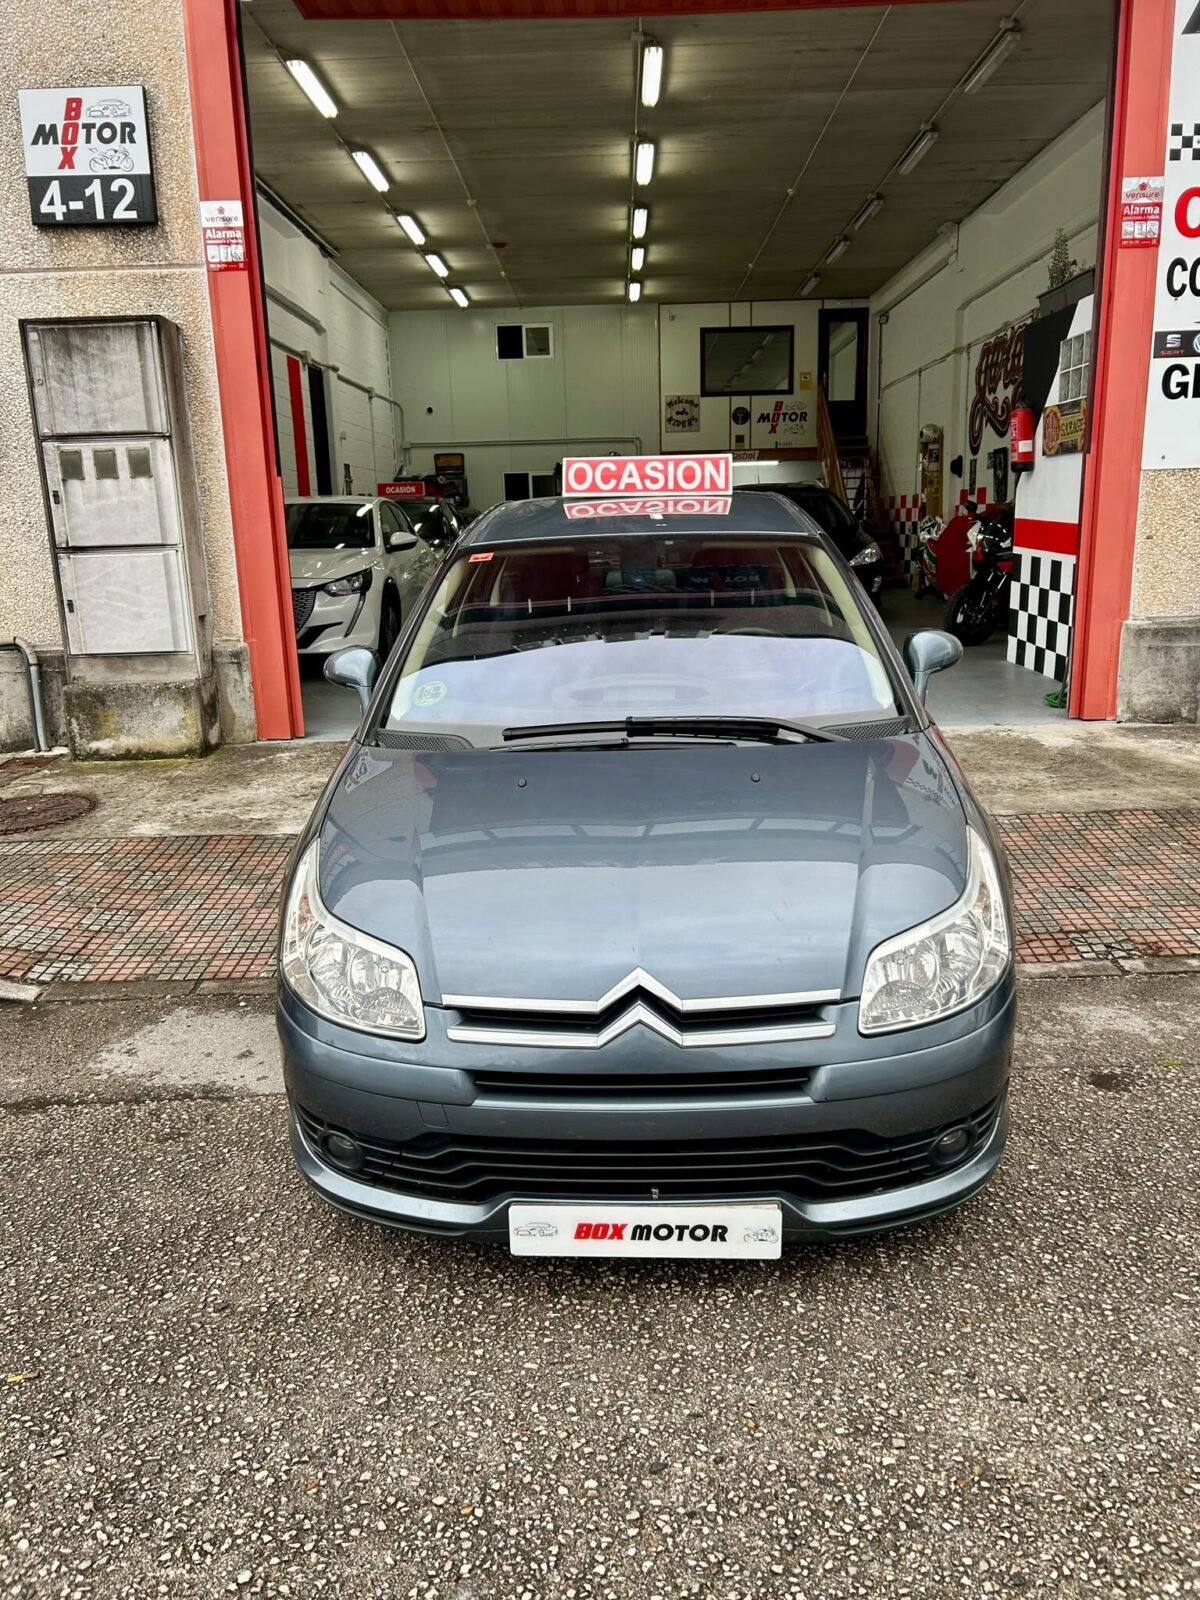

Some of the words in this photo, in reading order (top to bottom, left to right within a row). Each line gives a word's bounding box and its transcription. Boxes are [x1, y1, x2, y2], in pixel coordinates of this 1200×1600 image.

[31, 122, 136, 146] MOTOR
[58, 97, 83, 170] BOX
[39, 178, 138, 221] 4-12
[1126, 191, 1160, 199] verisure
[1123, 204, 1160, 215] Alarma
[206, 228, 242, 239] Alarma
[666, 396, 699, 408] Welcome
[757, 411, 808, 424] MOTOR
[568, 460, 725, 491] OCASION
[385, 486, 416, 494] OCASIÓN
[574, 1223, 628, 1240] BOX
[630, 1223, 728, 1242] MOTOR
